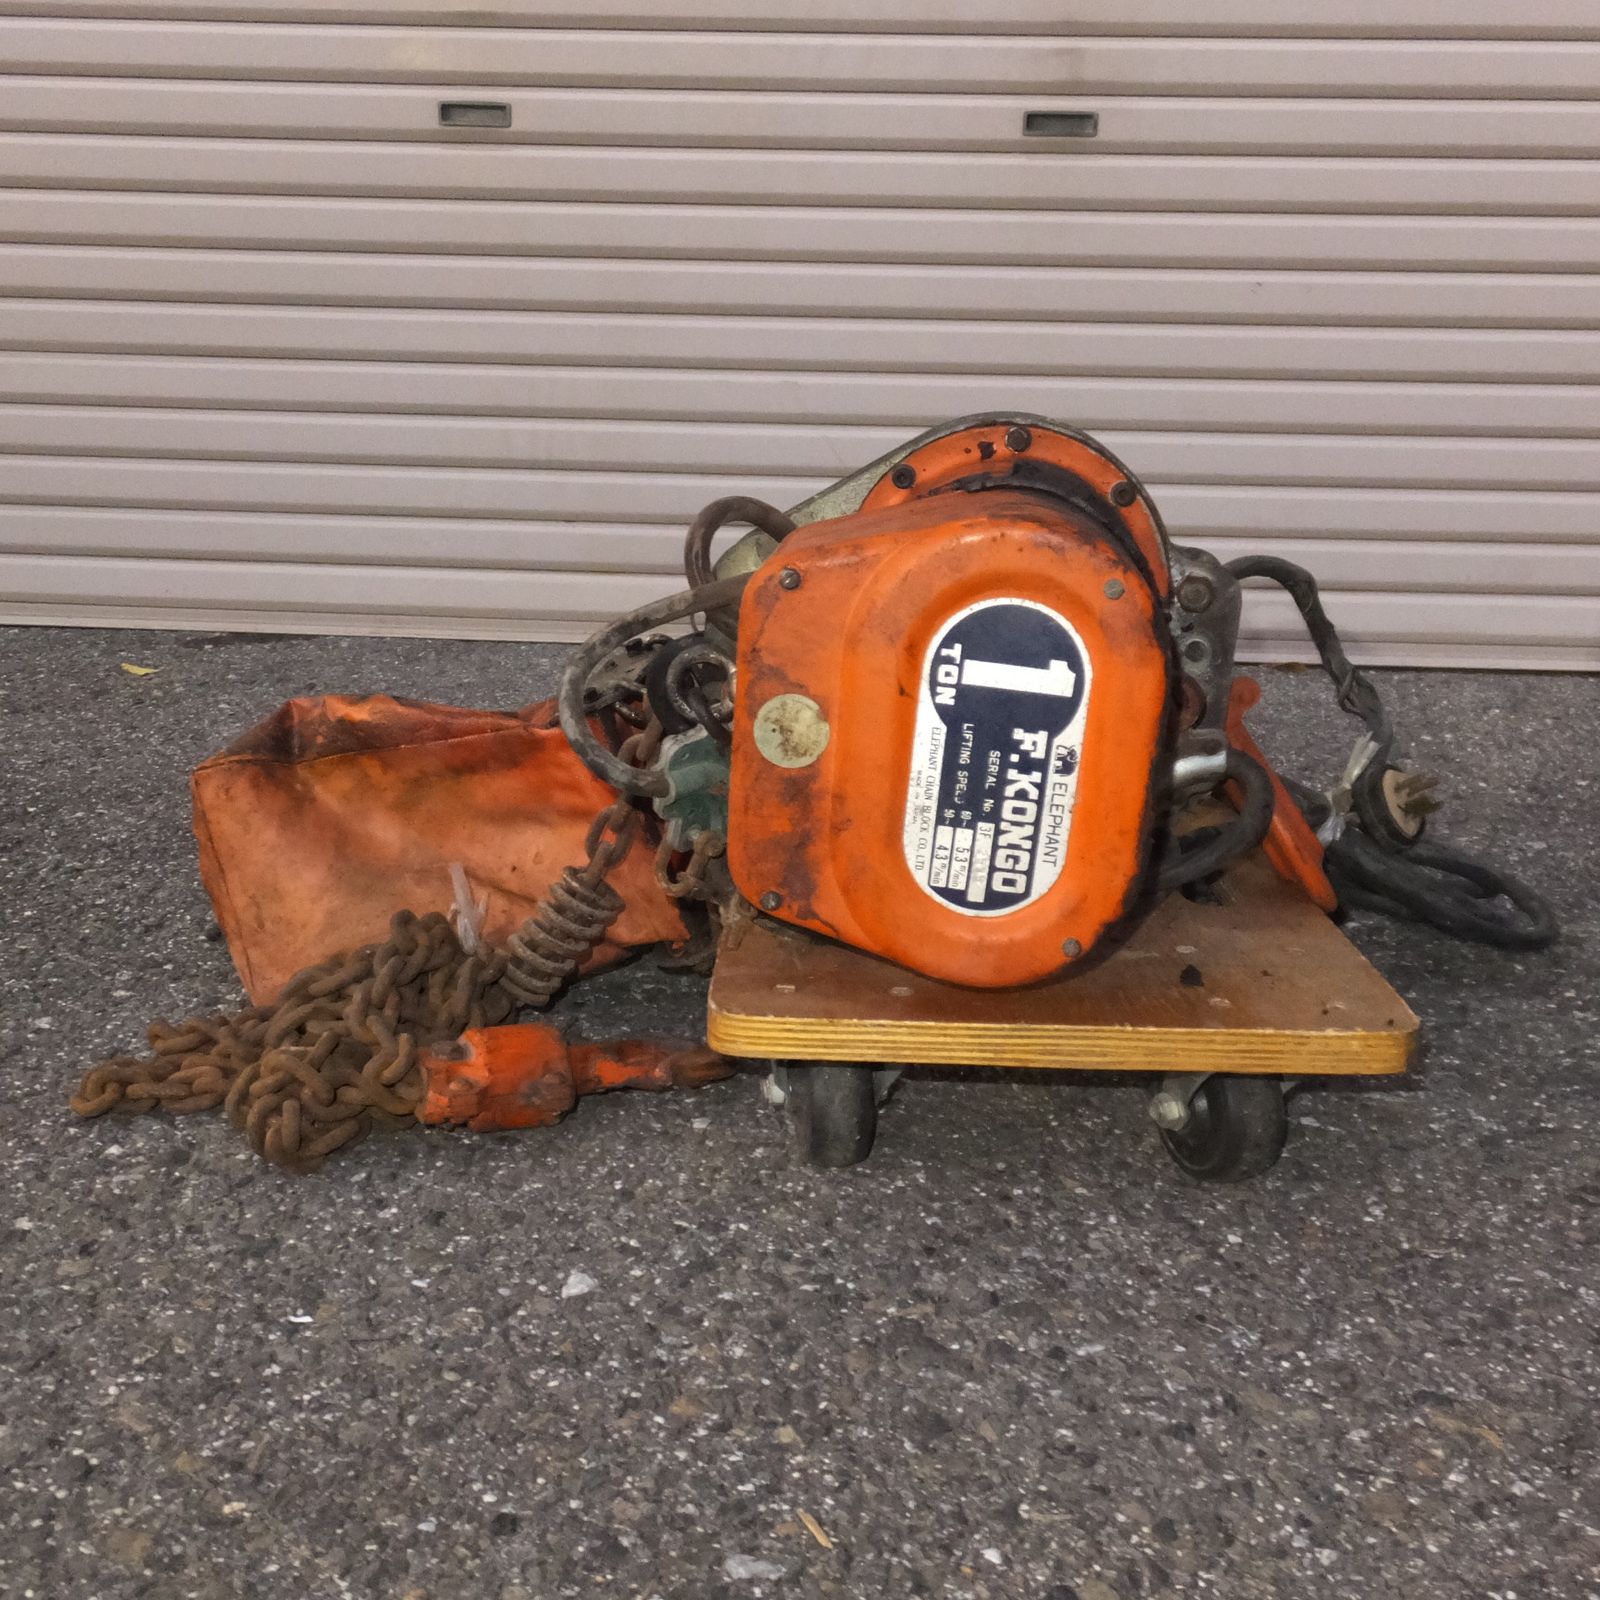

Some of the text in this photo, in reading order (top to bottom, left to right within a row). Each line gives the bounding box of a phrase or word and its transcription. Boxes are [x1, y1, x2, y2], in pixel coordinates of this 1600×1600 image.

[935, 643, 962, 705] TON
[961, 659, 1076, 699] 1
[927, 727, 941, 771] ELEPHANT
[959, 723, 974, 764] LIFTING
[923, 775, 936, 800] CHAIN
[984, 751, 1000, 789] SERIAL
[919, 806, 932, 833] BLOCK
[981, 799, 995, 817] No.
[992, 728, 1048, 893] F.KONGO
[1042, 782, 1067, 867] ELEPHANT
[934, 844, 948, 862] 4.3
